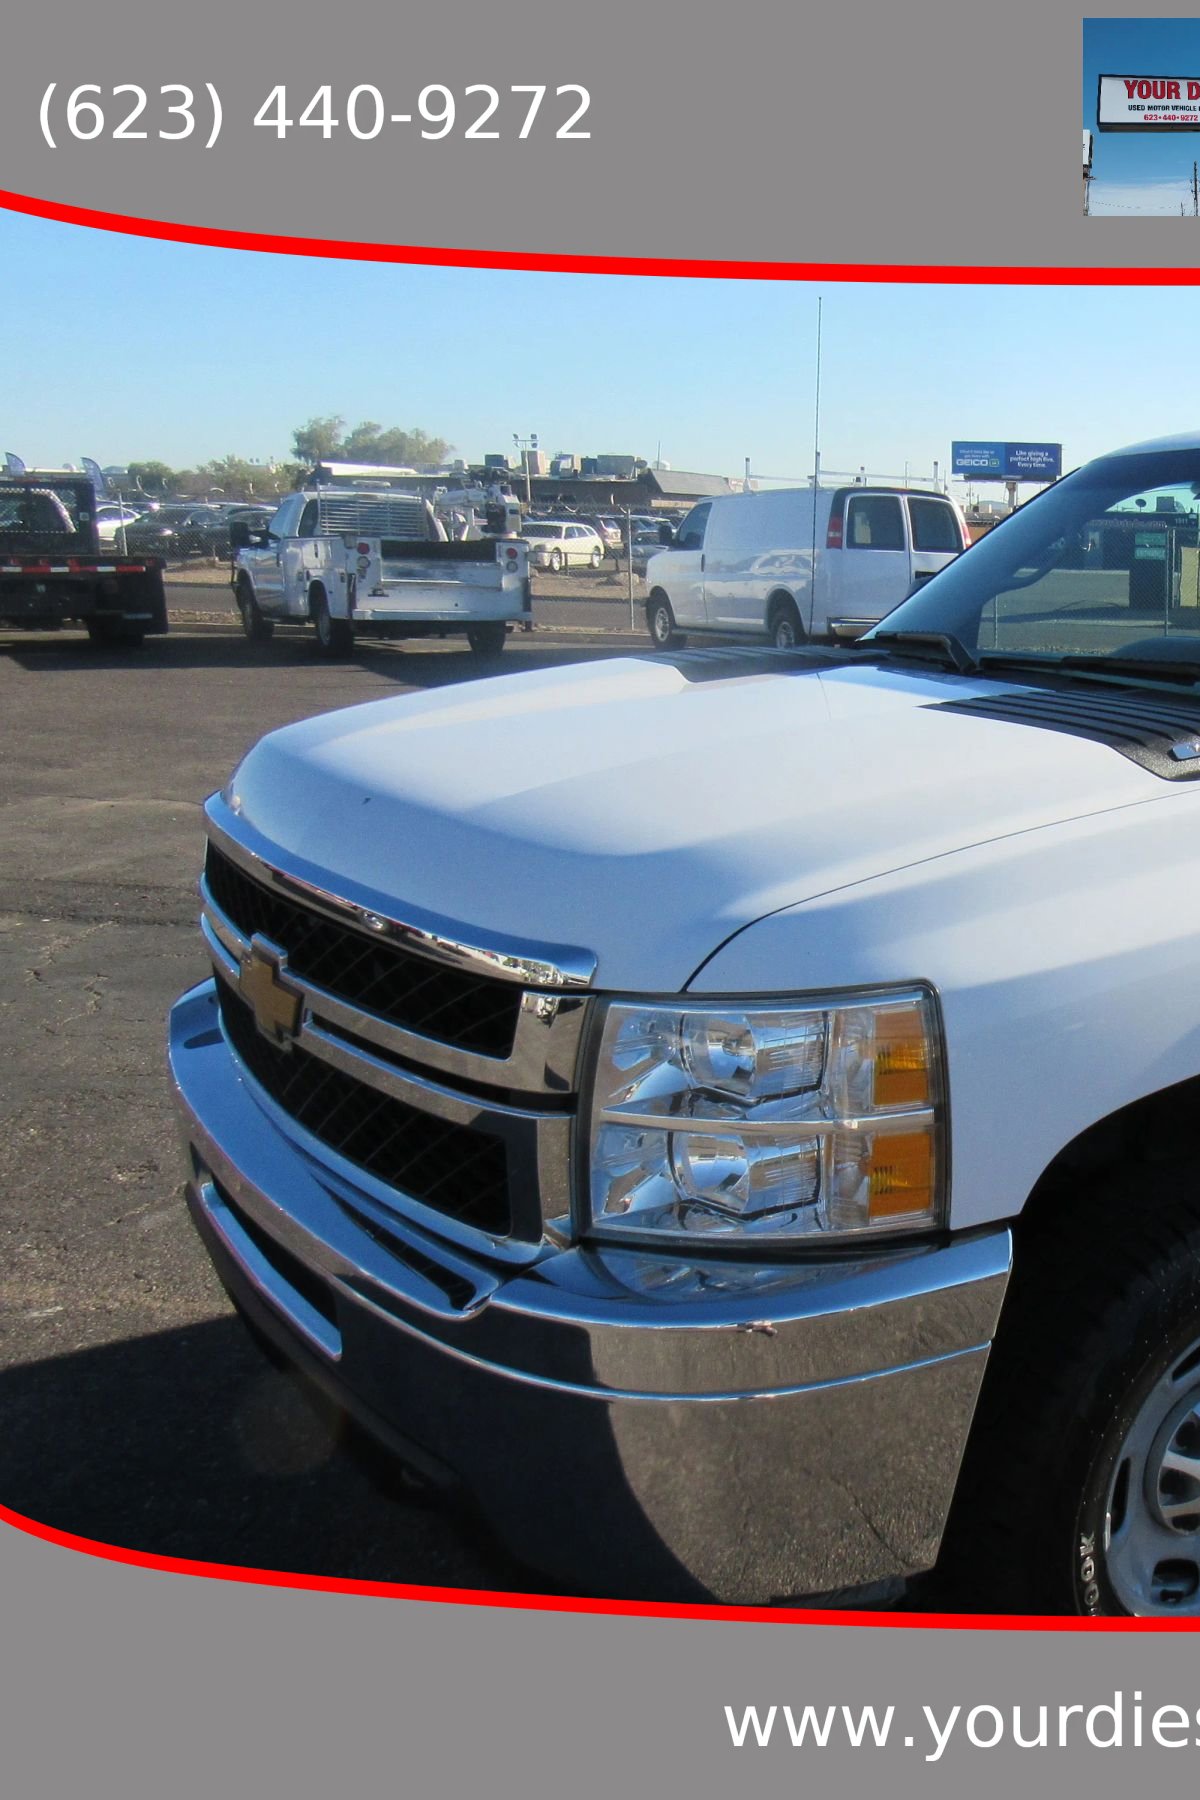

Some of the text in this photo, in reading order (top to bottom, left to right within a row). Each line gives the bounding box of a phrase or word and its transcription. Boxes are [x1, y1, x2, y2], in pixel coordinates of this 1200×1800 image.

[1124, 79, 1181, 100] YOUR
[1147, 104, 1170, 112] MOTOR
[1171, 104, 1197, 112] VEHICLE
[956, 459, 988, 467] GEICO
